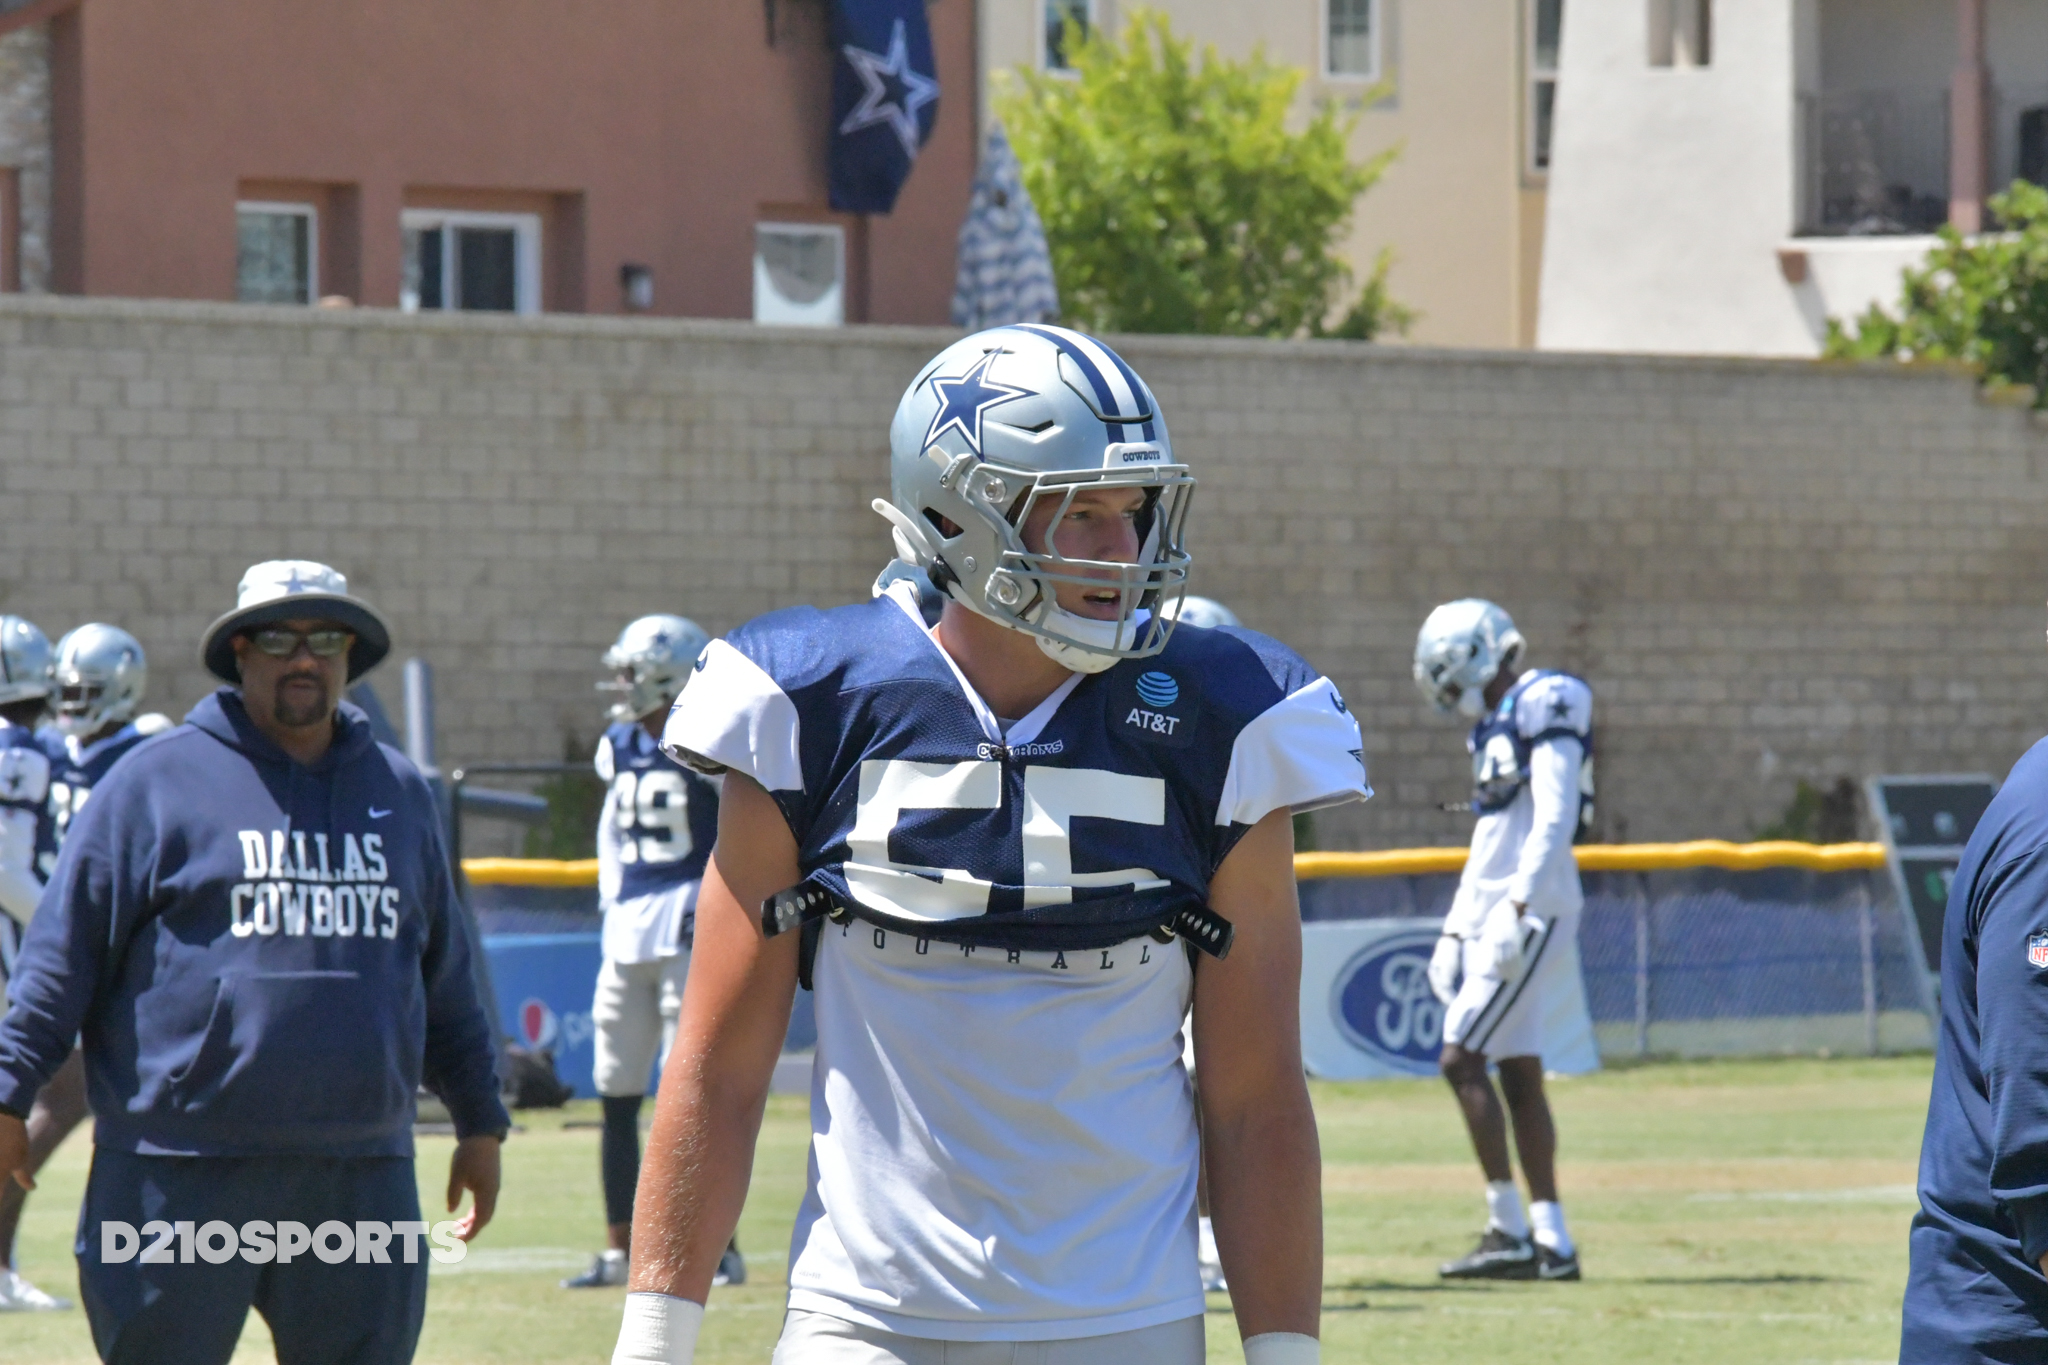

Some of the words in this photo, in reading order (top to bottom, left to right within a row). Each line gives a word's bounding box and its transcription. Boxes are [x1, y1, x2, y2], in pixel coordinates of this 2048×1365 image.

[1122, 450, 1161, 462] COWBOYS
[1125, 707, 1180, 735] AT&T
[237, 830, 388, 882] DALLAS
[230, 882, 399, 940] COWBOYS
[2032, 947, 2048, 962] NF
[1375, 952, 1446, 1050] Fo
